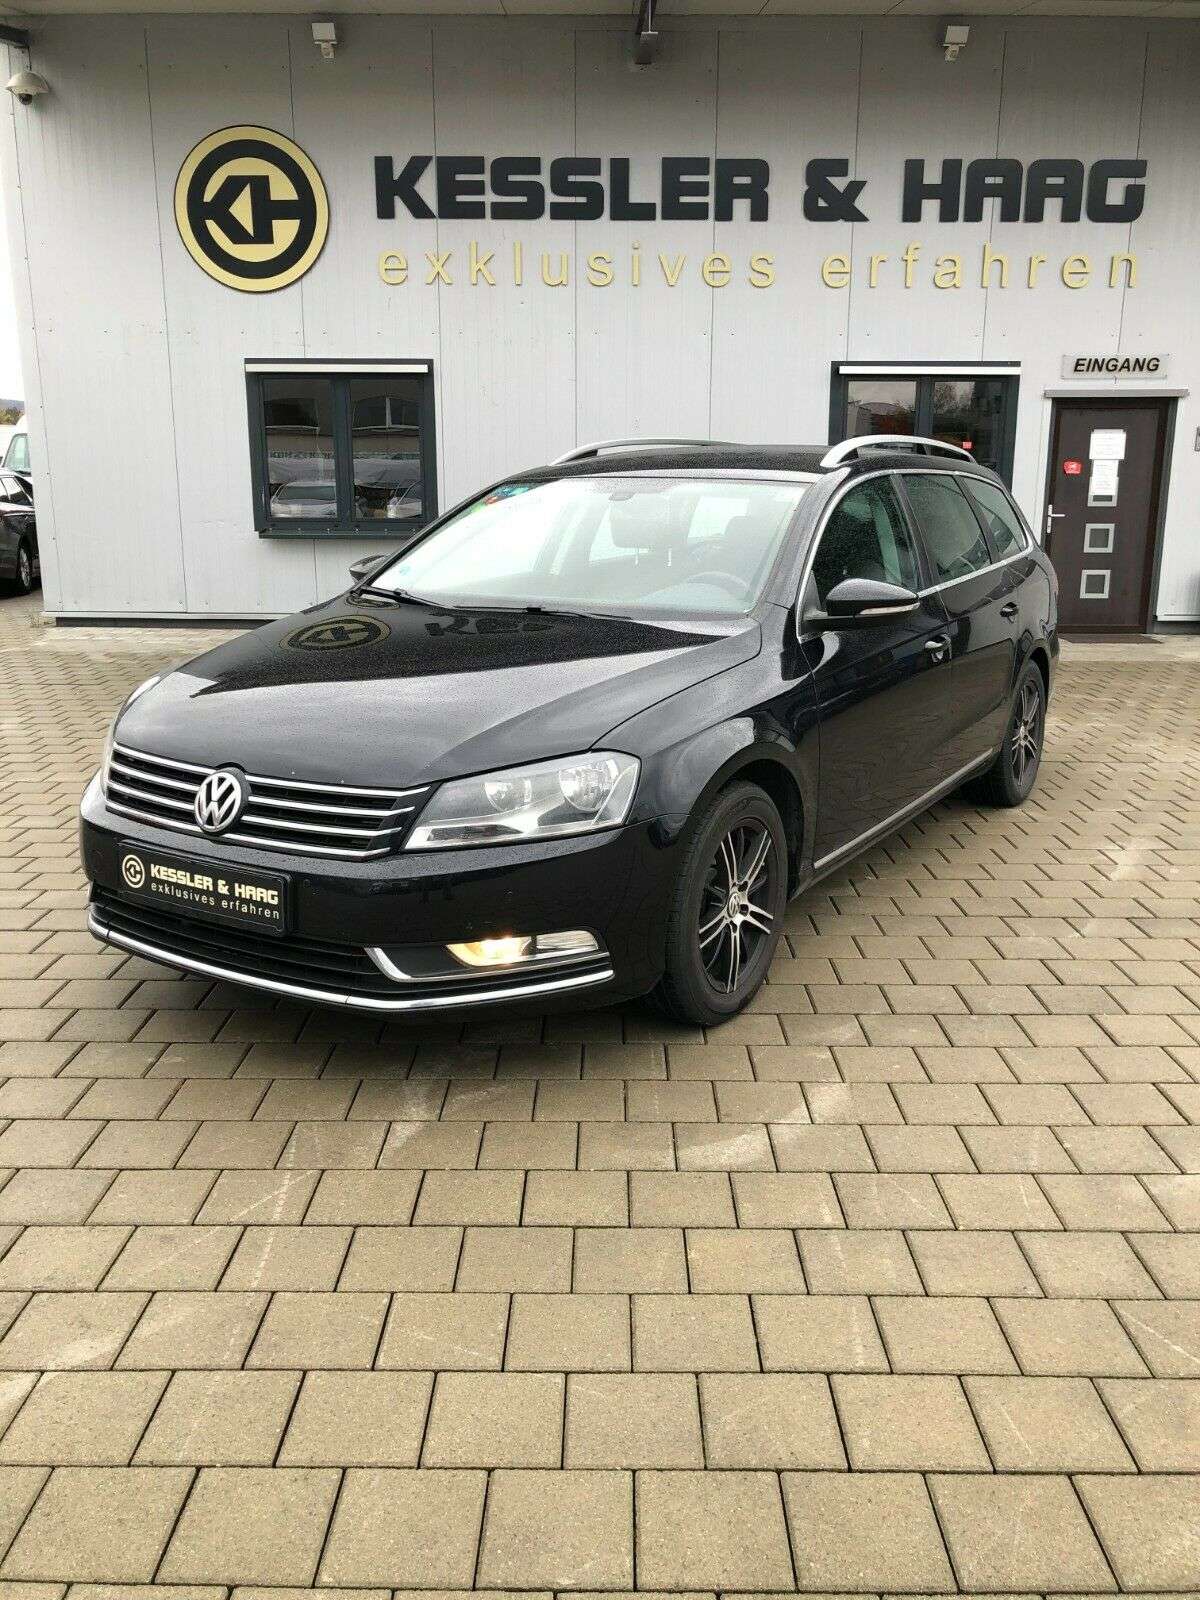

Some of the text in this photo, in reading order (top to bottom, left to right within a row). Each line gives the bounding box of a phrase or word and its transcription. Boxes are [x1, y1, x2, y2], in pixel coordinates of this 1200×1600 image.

[374, 156, 1148, 223] KESSLER & HAAG
[378, 241, 1138, 289] exklusives erfahren
[1073, 356, 1161, 373] EINGANG
[150, 864, 213, 890] KESSLER
[217, 879, 230, 896] &
[235, 883, 279, 905] HAAG
[151, 882, 280, 920] exklusives erfahren
